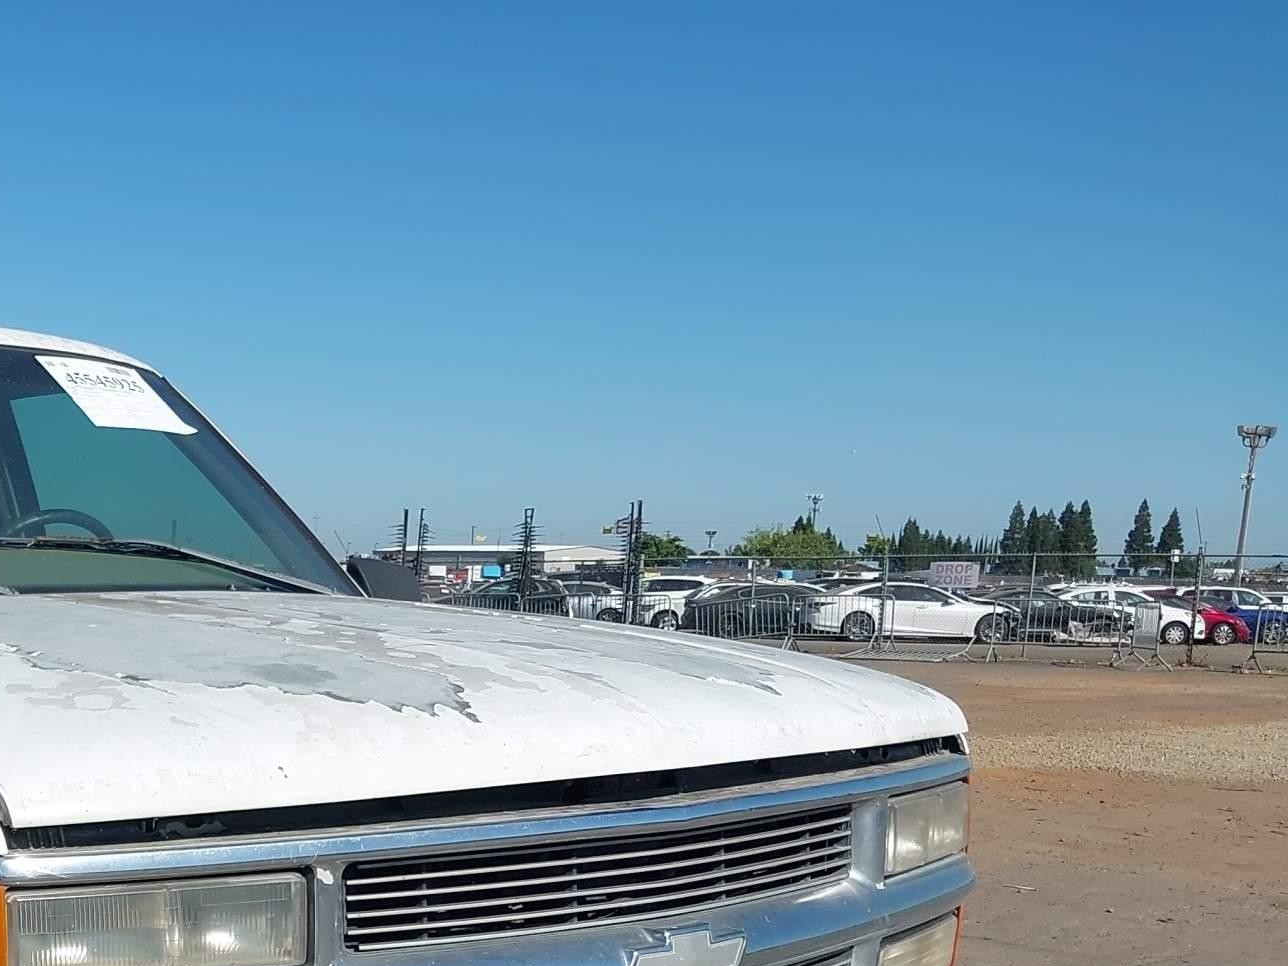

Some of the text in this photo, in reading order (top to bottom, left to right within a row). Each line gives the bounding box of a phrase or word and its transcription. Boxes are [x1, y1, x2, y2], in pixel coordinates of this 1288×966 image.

[66, 372, 144, 393] 45545925
[935, 564, 973, 575] DROP
[935, 575, 973, 585] ZONE
